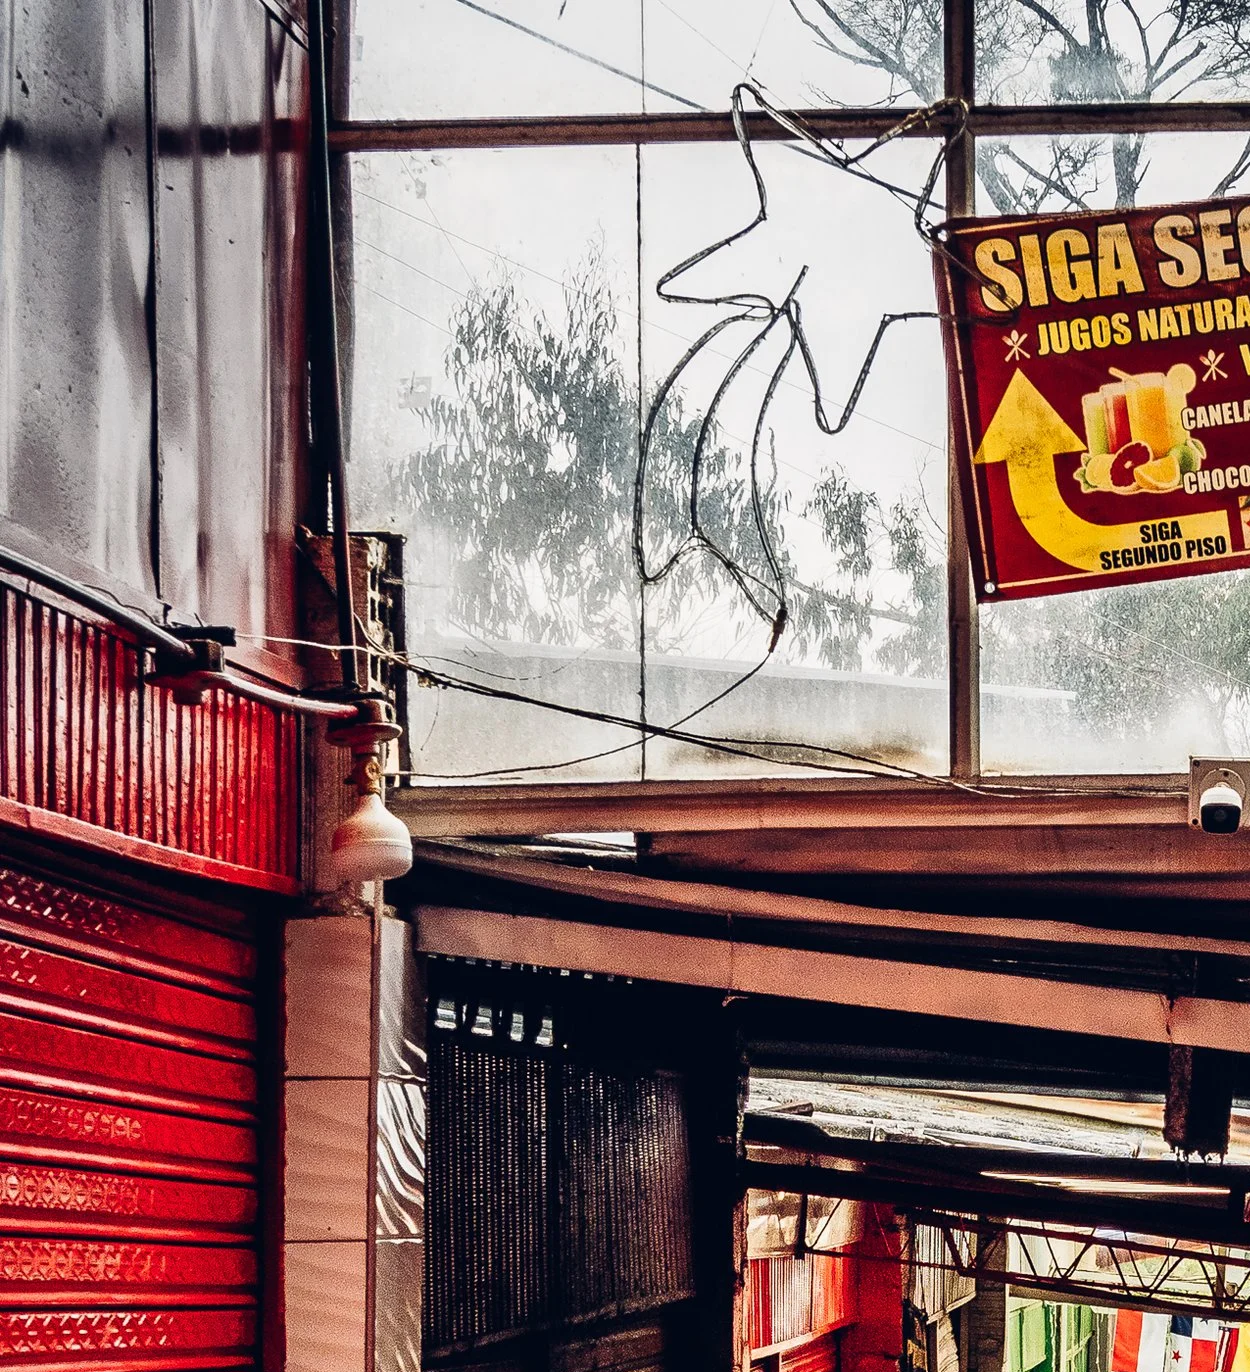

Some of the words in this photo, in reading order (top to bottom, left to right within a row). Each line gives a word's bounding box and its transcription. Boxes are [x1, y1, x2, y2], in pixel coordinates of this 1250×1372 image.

[974, 223, 1147, 312] SIGA
[1037, 316, 1132, 356] JUGOS
[1139, 520, 1182, 544] SIGA
[1100, 542, 1181, 570] SEGUNDO
[1185, 535, 1227, 558] PISO
